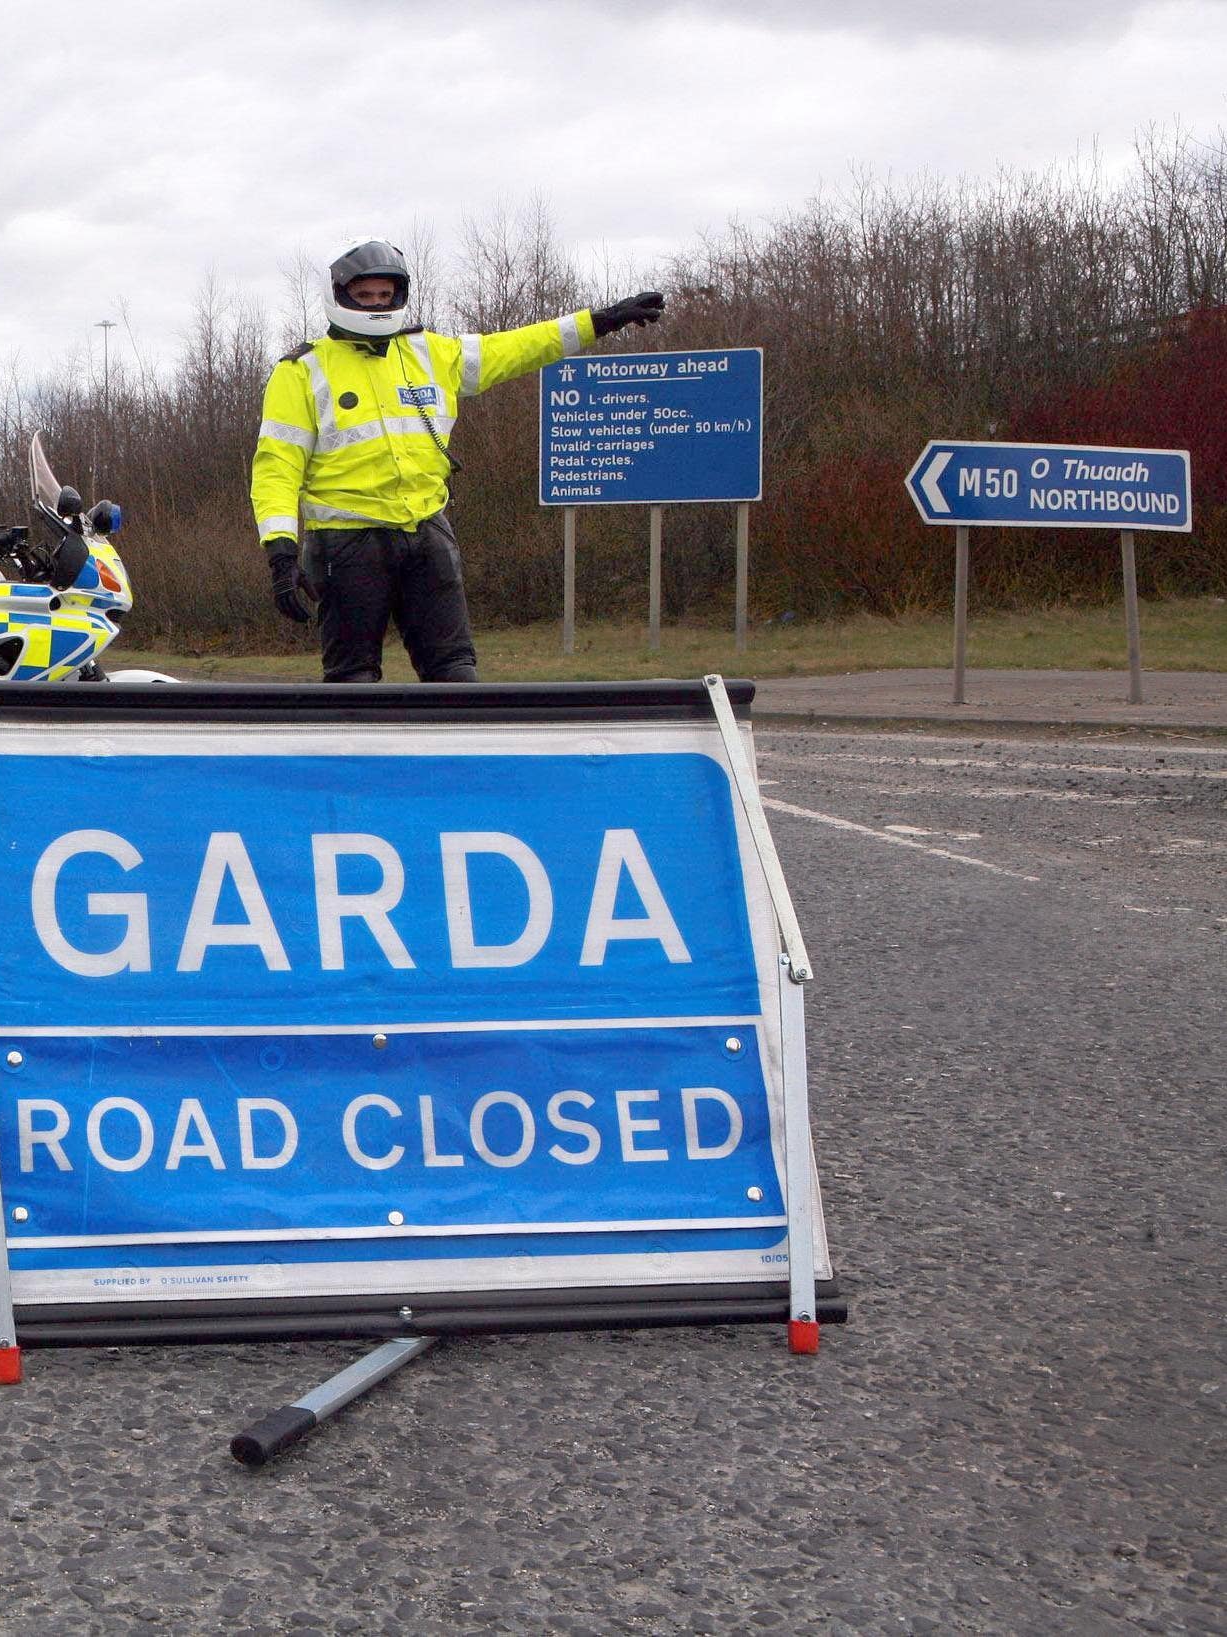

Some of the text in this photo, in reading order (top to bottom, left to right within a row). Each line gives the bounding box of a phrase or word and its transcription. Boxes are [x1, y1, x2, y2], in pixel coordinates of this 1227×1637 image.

[587, 357, 729, 377] Motorway ahead
[550, 390, 650, 406] NO L-drivers.
[552, 411, 604, 422] Vehicles
[610, 409, 647, 420] under
[551, 418, 752, 437] Slow vehicles (under 50 km/h)
[550, 470, 627, 481] Pedestrians.
[1030, 458, 1050, 479] O
[550, 485, 602, 497] Animals
[958, 467, 1018, 498] M50
[1030, 489, 1180, 514] NORTHBOUND
[30, 827, 692, 978] GARDA
[17, 1087, 744, 1174] ROAD CLOSED
[93, 1277, 137, 1286] SUPPLIED
[139, 1277, 150, 1285] BY
[217, 1275, 249, 1284] SAFETY
